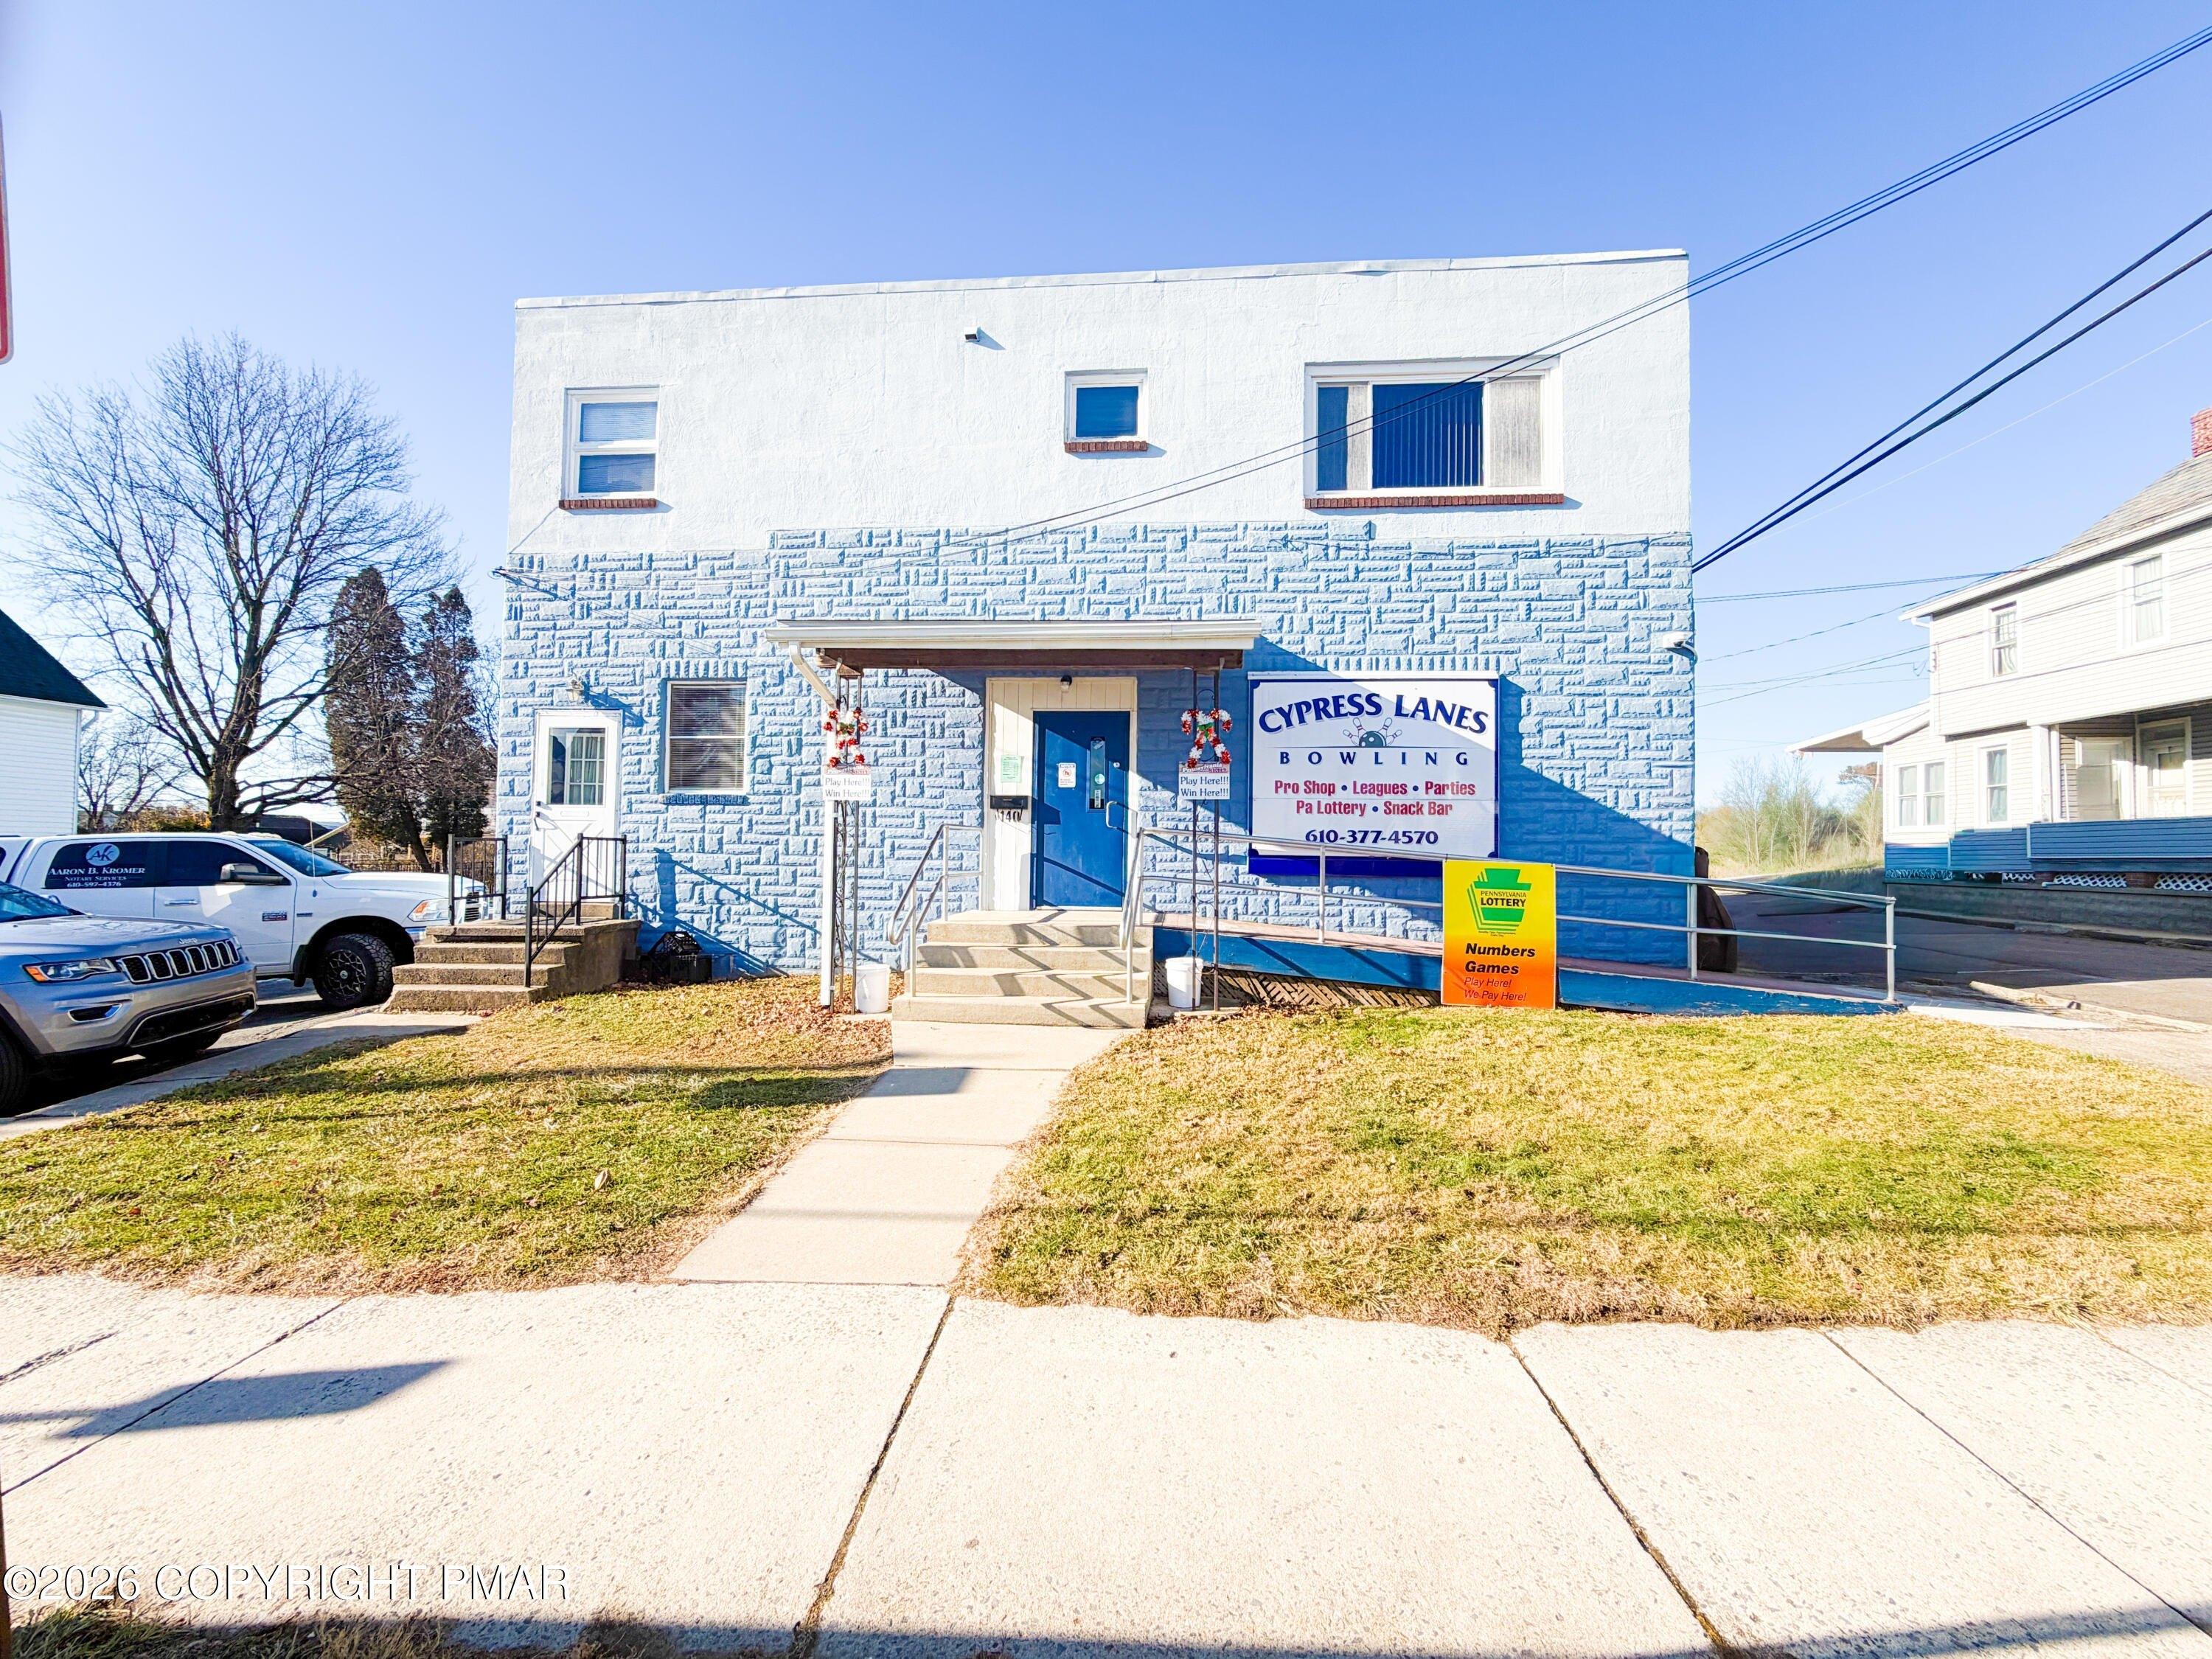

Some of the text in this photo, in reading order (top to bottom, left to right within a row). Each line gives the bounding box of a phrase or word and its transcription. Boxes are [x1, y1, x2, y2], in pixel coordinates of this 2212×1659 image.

[1259, 692, 1489, 734] CYPRESS LANES
[1280, 751, 1468, 765] BOWLING
[825, 777, 870, 787] Play Here!!!
[1180, 776, 1228, 786] Play Here!!!
[825, 789, 869, 797] Win Here!!!
[1180, 788, 1228, 796] Win Here!!!
[1274, 780, 1475, 796] Pro Shop Leagues Parties
[1296, 800, 1453, 817] Pa Lottery Snack Bar
[1305, 830, 1439, 844] 610-377-4570
[1481, 897, 1526, 908] LOTTERY
[1465, 943, 1536, 958] Numbers
[1464, 960, 1519, 974] Games
[1464, 977, 1512, 988] Play Here!
[1464, 990, 1526, 1001] We Pay Here!
